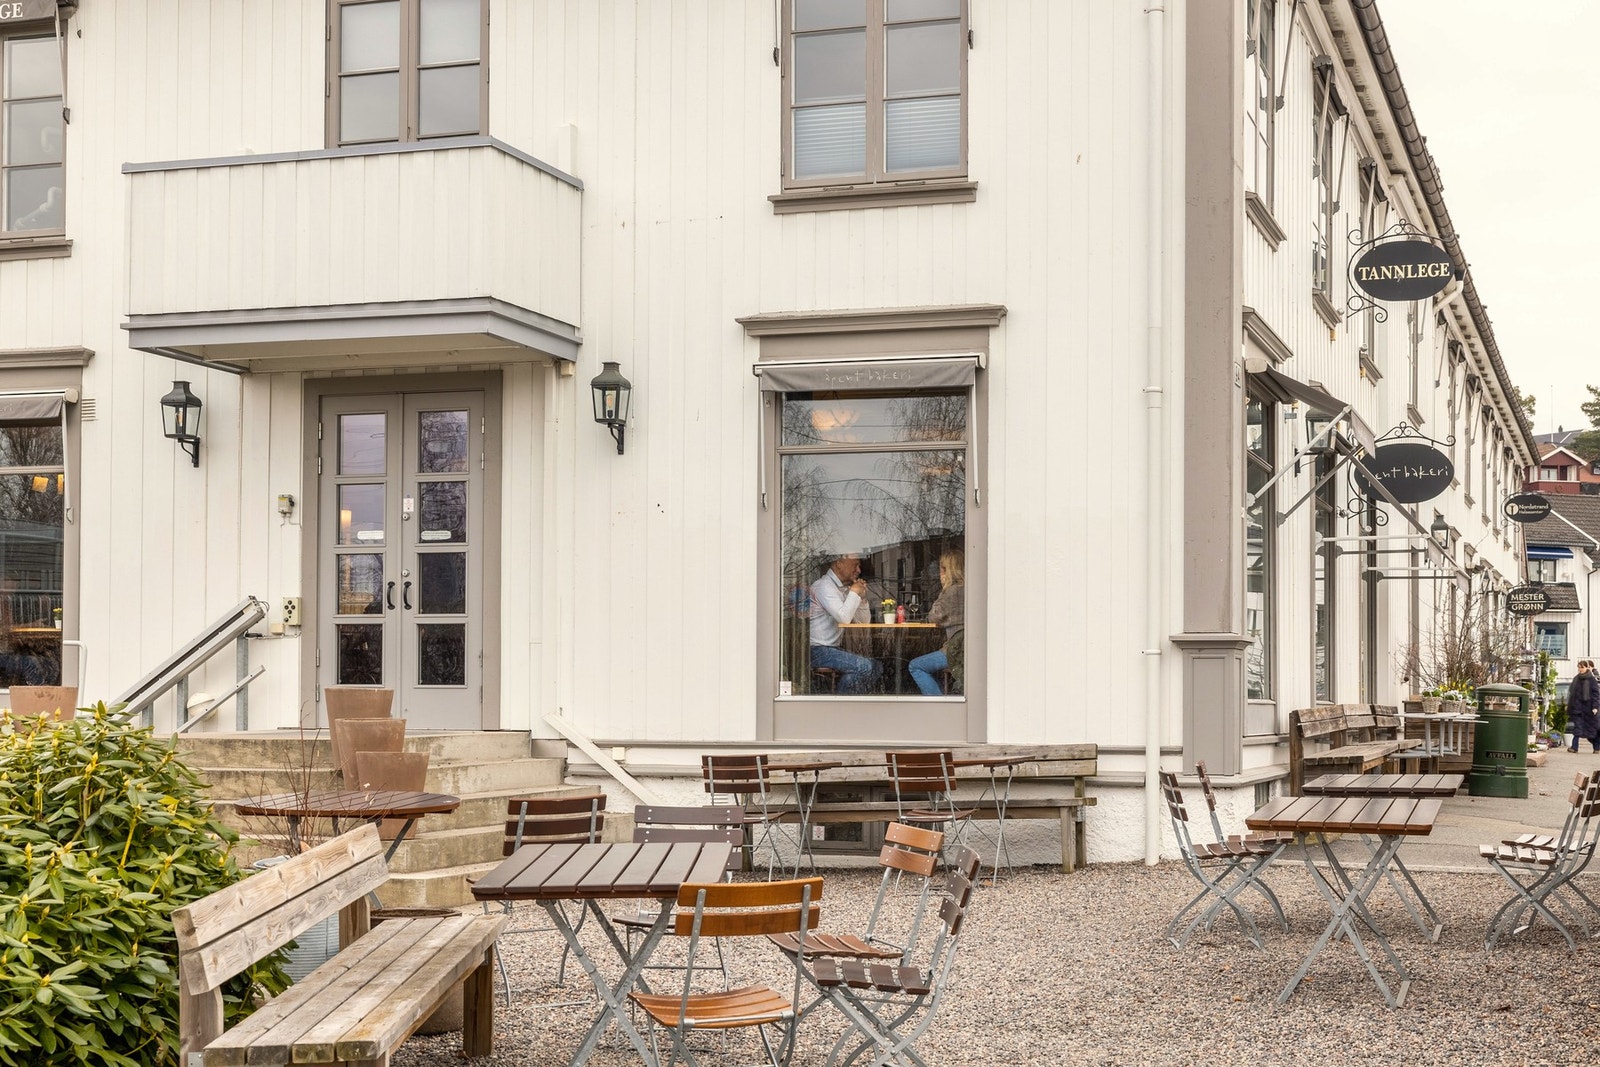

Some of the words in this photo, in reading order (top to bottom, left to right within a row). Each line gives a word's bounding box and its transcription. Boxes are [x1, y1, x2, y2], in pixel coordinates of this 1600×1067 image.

[1358, 262, 1450, 281] TANNLEGE
[868, 368, 911, 382] bakeri
[1362, 466, 1401, 488] ent
[1404, 465, 1449, 480] bakeri
[1511, 593, 1545, 601] MESTER
[1511, 603, 1544, 611] GRØNN
